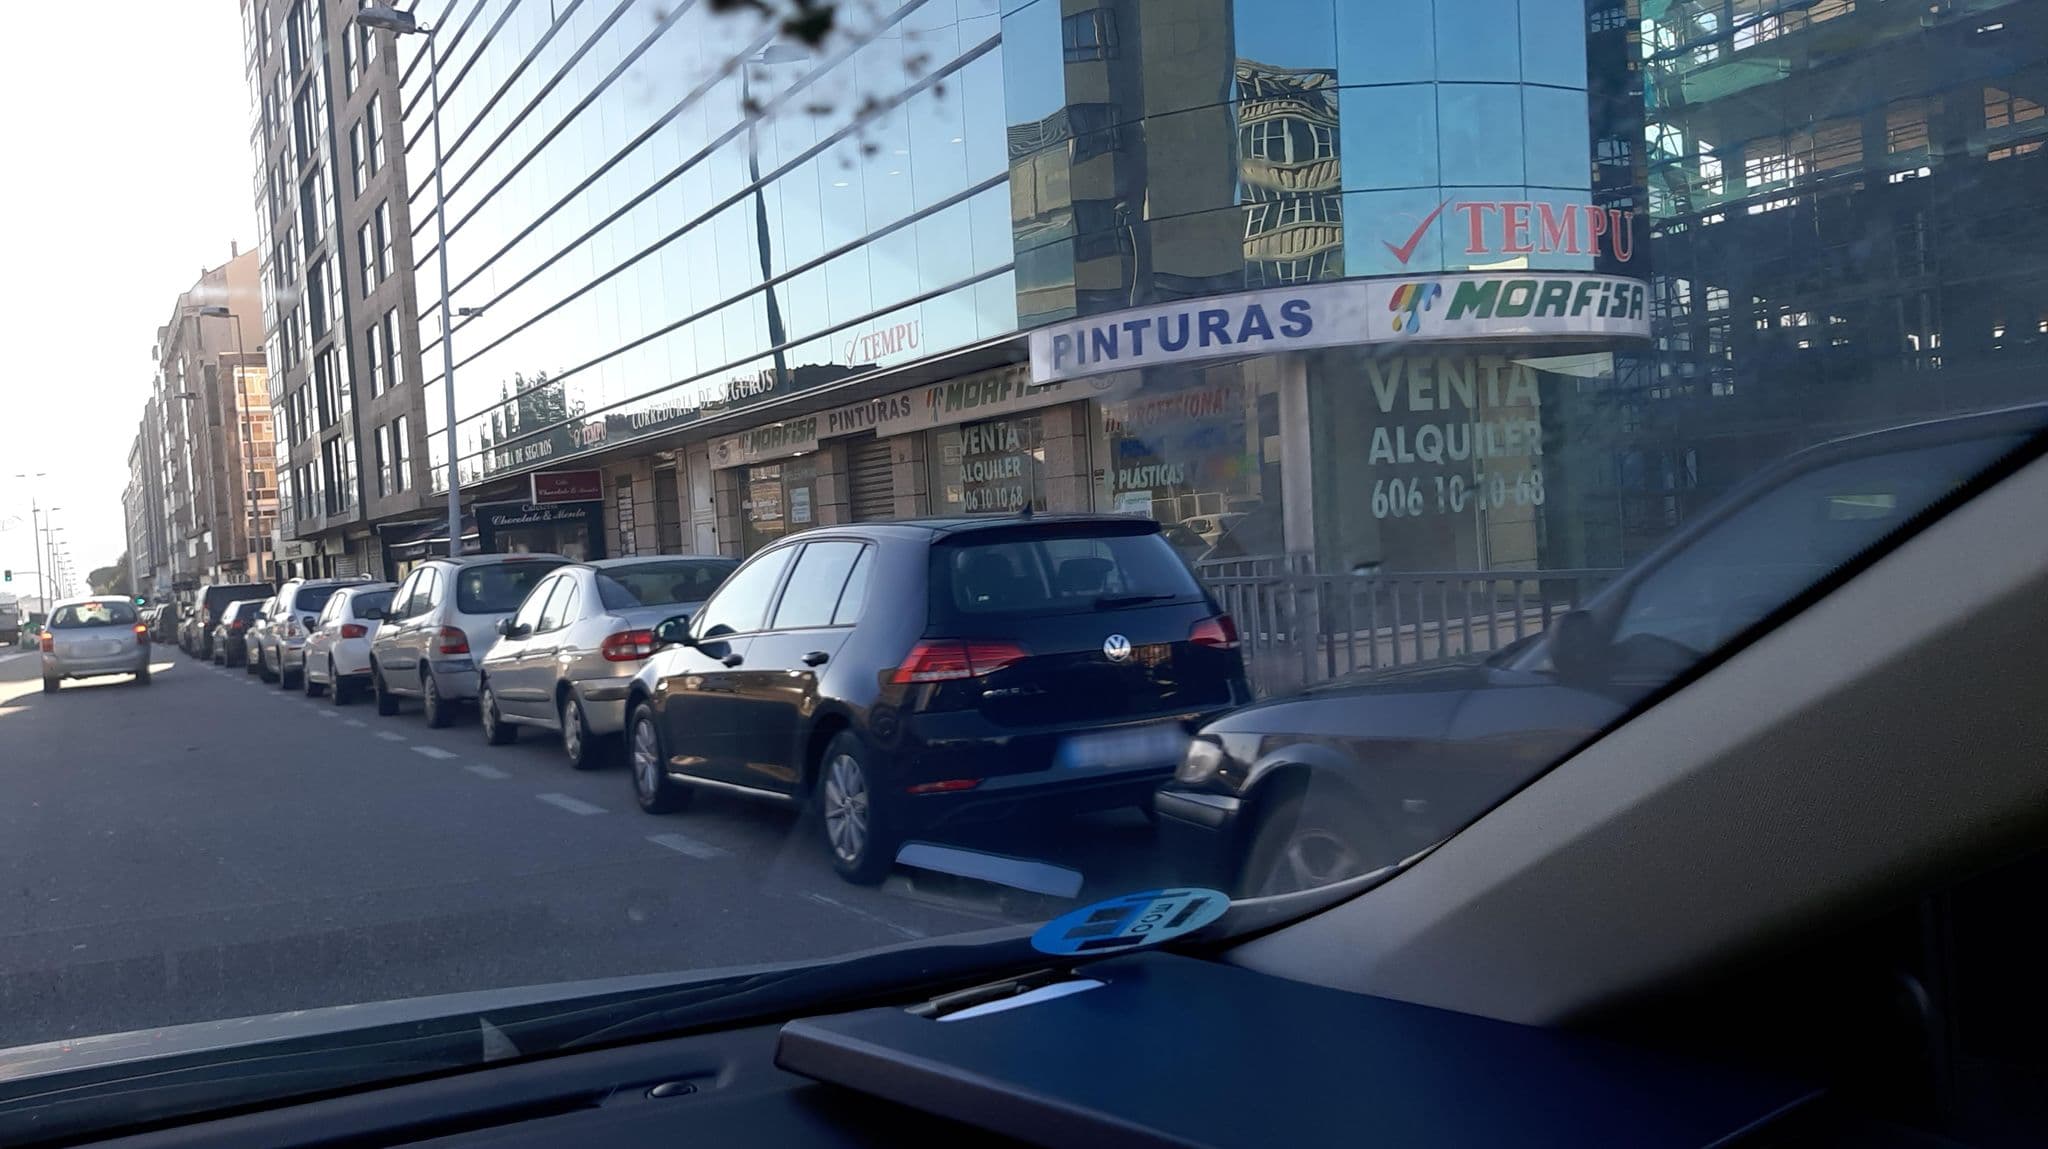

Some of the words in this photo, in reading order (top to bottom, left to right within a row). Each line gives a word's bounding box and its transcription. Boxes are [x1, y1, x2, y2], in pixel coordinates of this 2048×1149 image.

[1456, 201, 1634, 263] TEMPU
[860, 320, 919, 362] TEMPU
[1052, 299, 1313, 371] PINTURAS
[698, 387, 713, 411] DE
[718, 369, 774, 408] SEGUROS
[1364, 355, 1542, 413] VENTA
[582, 421, 607, 445] TEMPU
[828, 395, 911, 433] PINTURAS
[960, 422, 1021, 456] VENTA
[1368, 416, 1544, 465] ALQUILER
[960, 457, 1022, 483] ALQUILER
[1118, 461, 1185, 490] PLÁSTICAS
[981, 488, 993, 509] 10
[996, 487, 1008, 508] 10
[1010, 485, 1023, 507] 68
[1371, 477, 1424, 519] 606
[1433, 474, 1465, 514] 10
[1477, 471, 1505, 510] 10
[1516, 469, 1545, 506] 68
[543, 510, 552, 520] &
